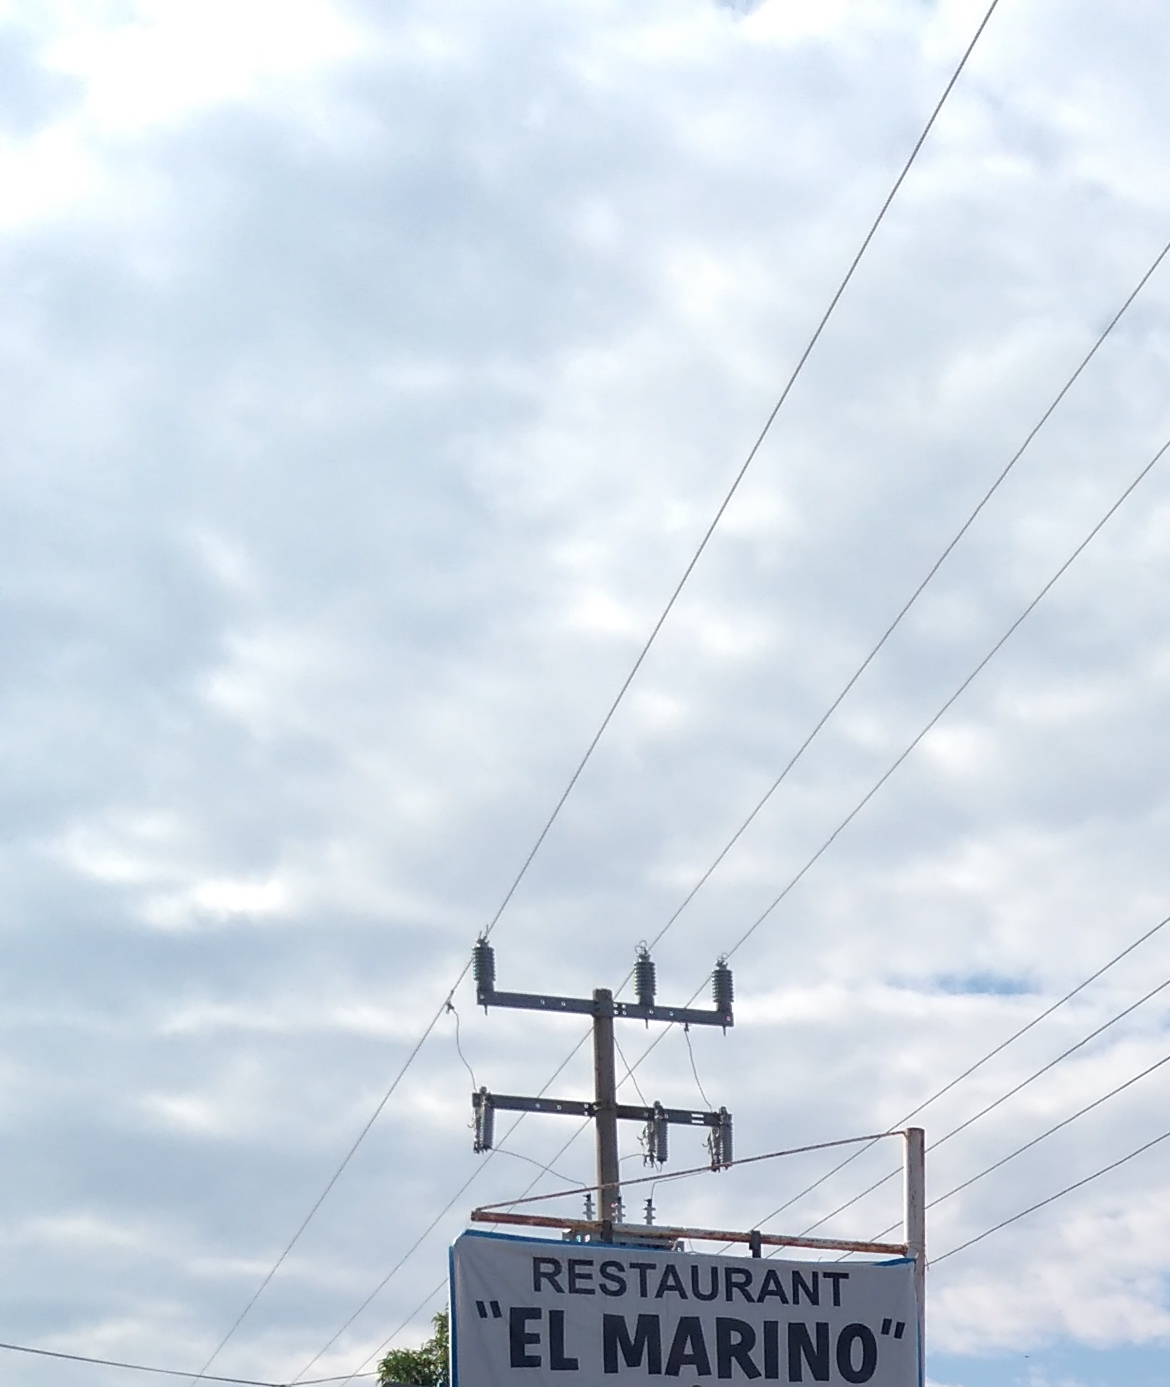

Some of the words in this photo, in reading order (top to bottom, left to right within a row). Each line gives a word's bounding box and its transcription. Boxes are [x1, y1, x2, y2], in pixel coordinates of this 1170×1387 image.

[532, 1256, 850, 1307] RESTAURANT
[475, 1300, 579, 1371] "EL
[602, 1313, 906, 1384] MARINO"
